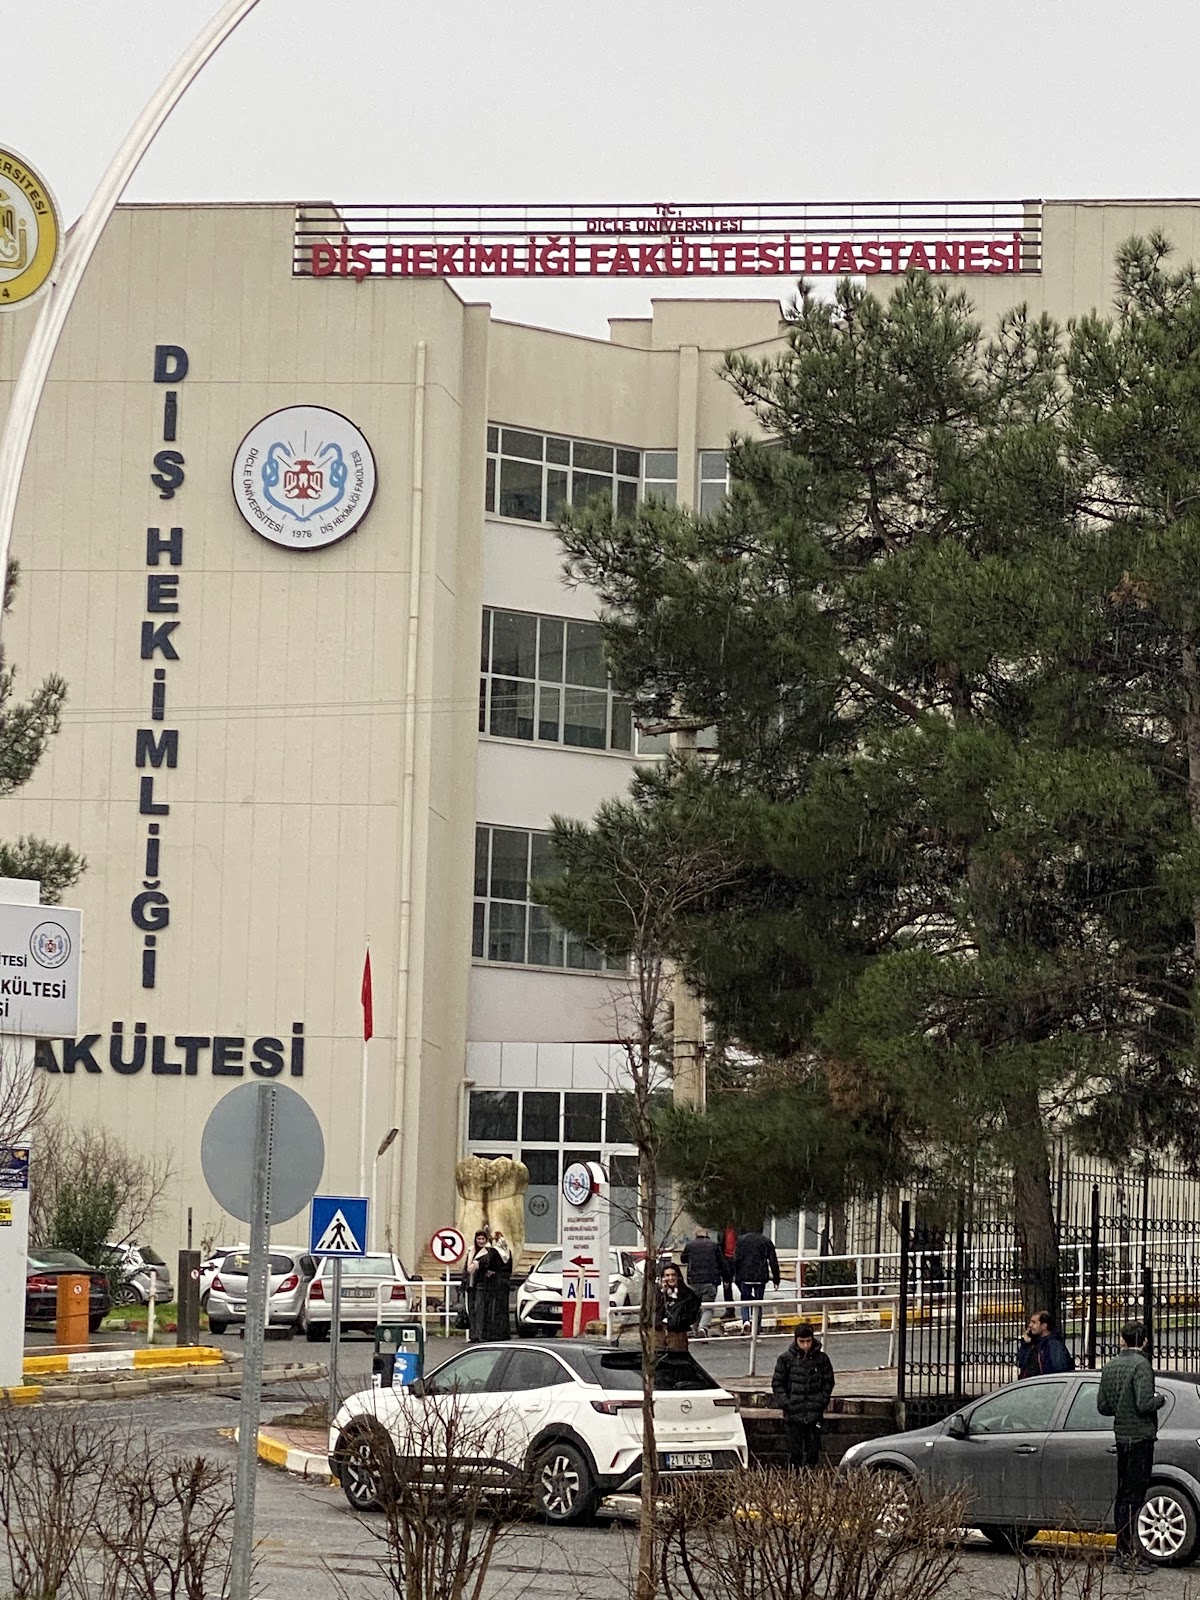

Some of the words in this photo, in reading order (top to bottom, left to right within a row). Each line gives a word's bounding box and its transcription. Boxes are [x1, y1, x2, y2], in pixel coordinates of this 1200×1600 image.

[311, 235, 373, 283] DİŞ
[385, 235, 576, 277] HEKİMLİĞİ
[590, 234, 791, 276] FAKÜLTESİ
[804, 232, 1022, 275] HASTANESİ
[151, 345, 188, 499] DİŞ
[242, 447, 259, 477] DİCLE
[242, 478, 284, 533] ÜNİVERSİTESİ
[291, 530, 312, 538] 1976
[320, 522, 334, 534] DİŞ
[131, 528, 183, 989] HEKİMLİĞİ
[0, 951, 27, 968] TESİ
[567, 1279, 595, 1299] AİL
